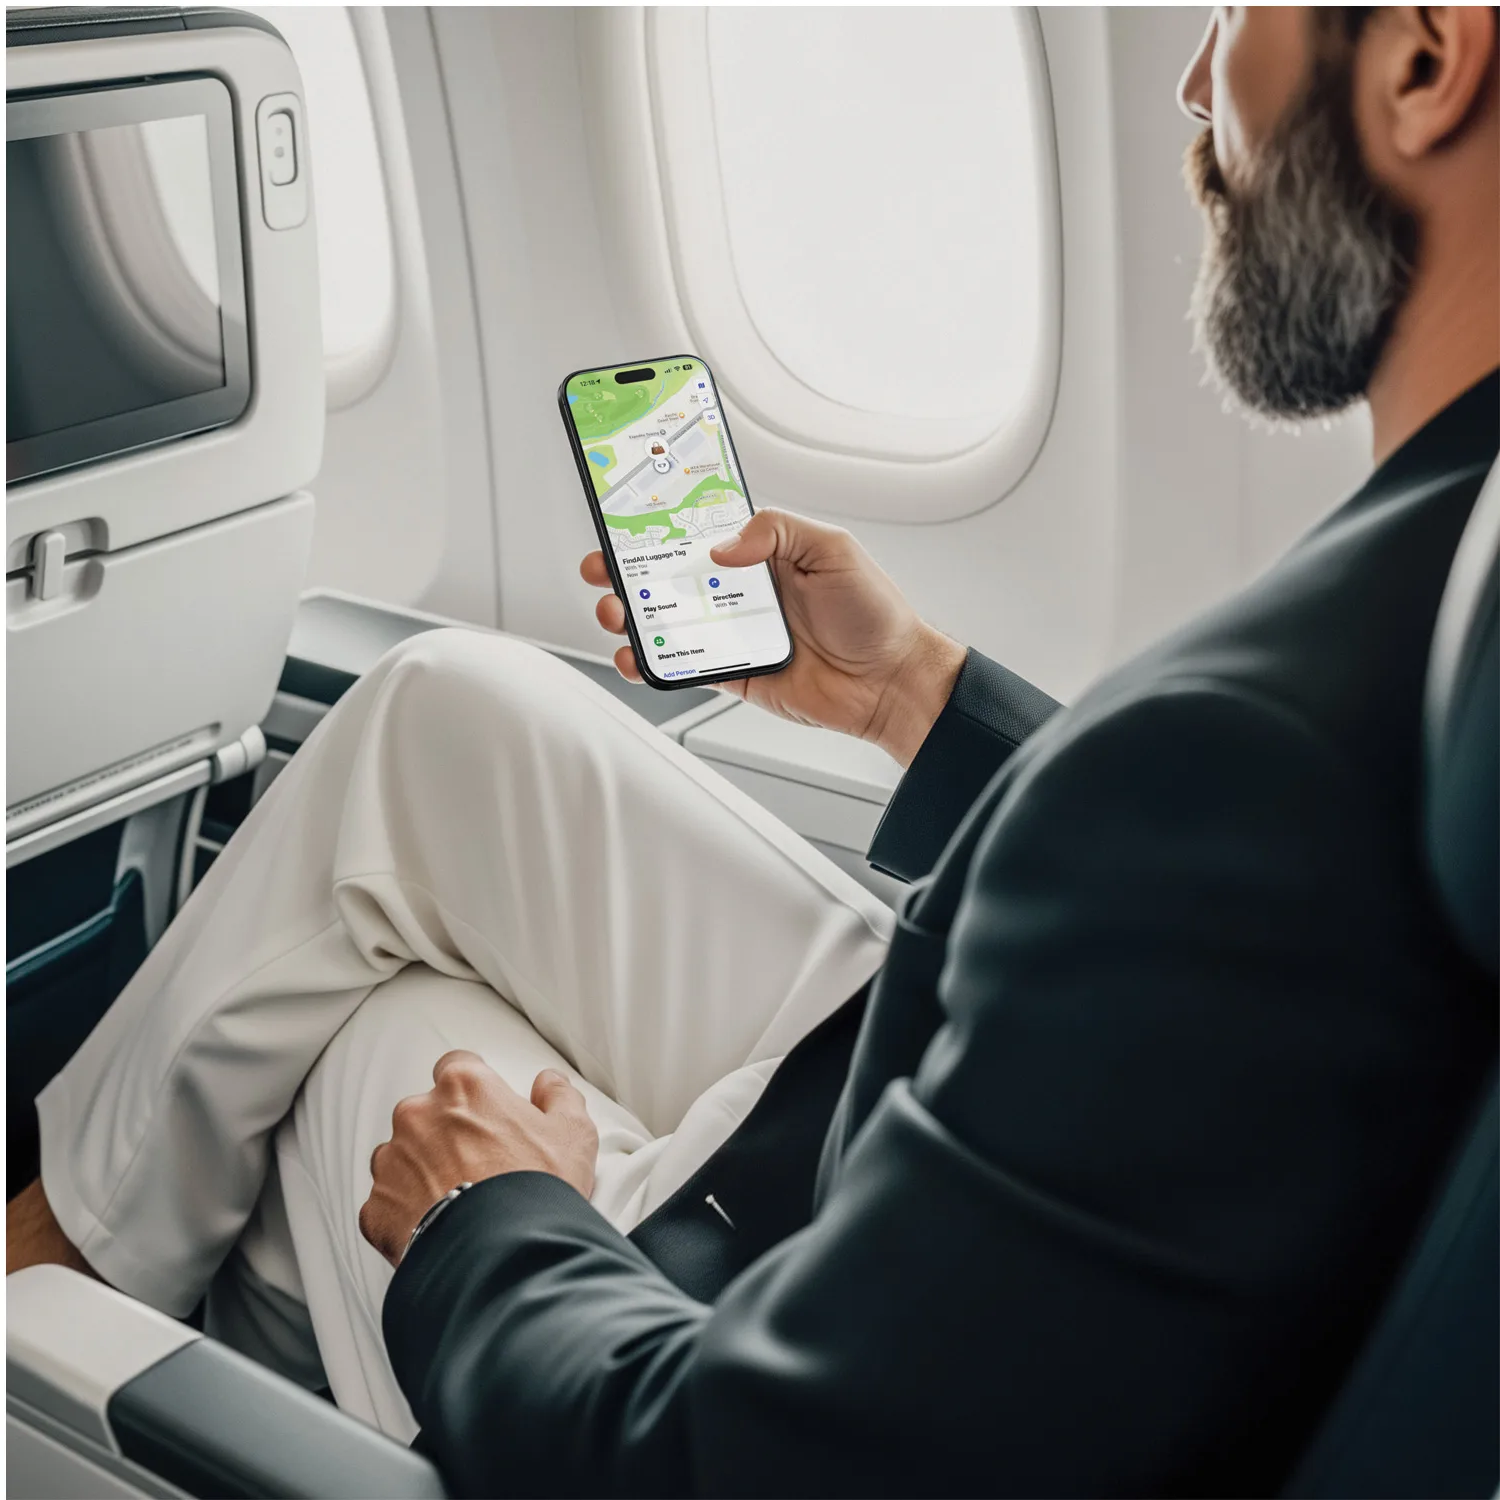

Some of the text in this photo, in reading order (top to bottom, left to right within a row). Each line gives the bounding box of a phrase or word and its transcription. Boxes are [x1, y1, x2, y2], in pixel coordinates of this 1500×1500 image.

[580, 379, 595, 387] 12:18
[622, 555, 645, 564] FindAll
[645, 552, 673, 561] Luggage
[712, 591, 744, 602] Directions
[657, 602, 677, 610] Sound
[658, 652, 676, 660] Share
[676, 669, 696, 677] Person
